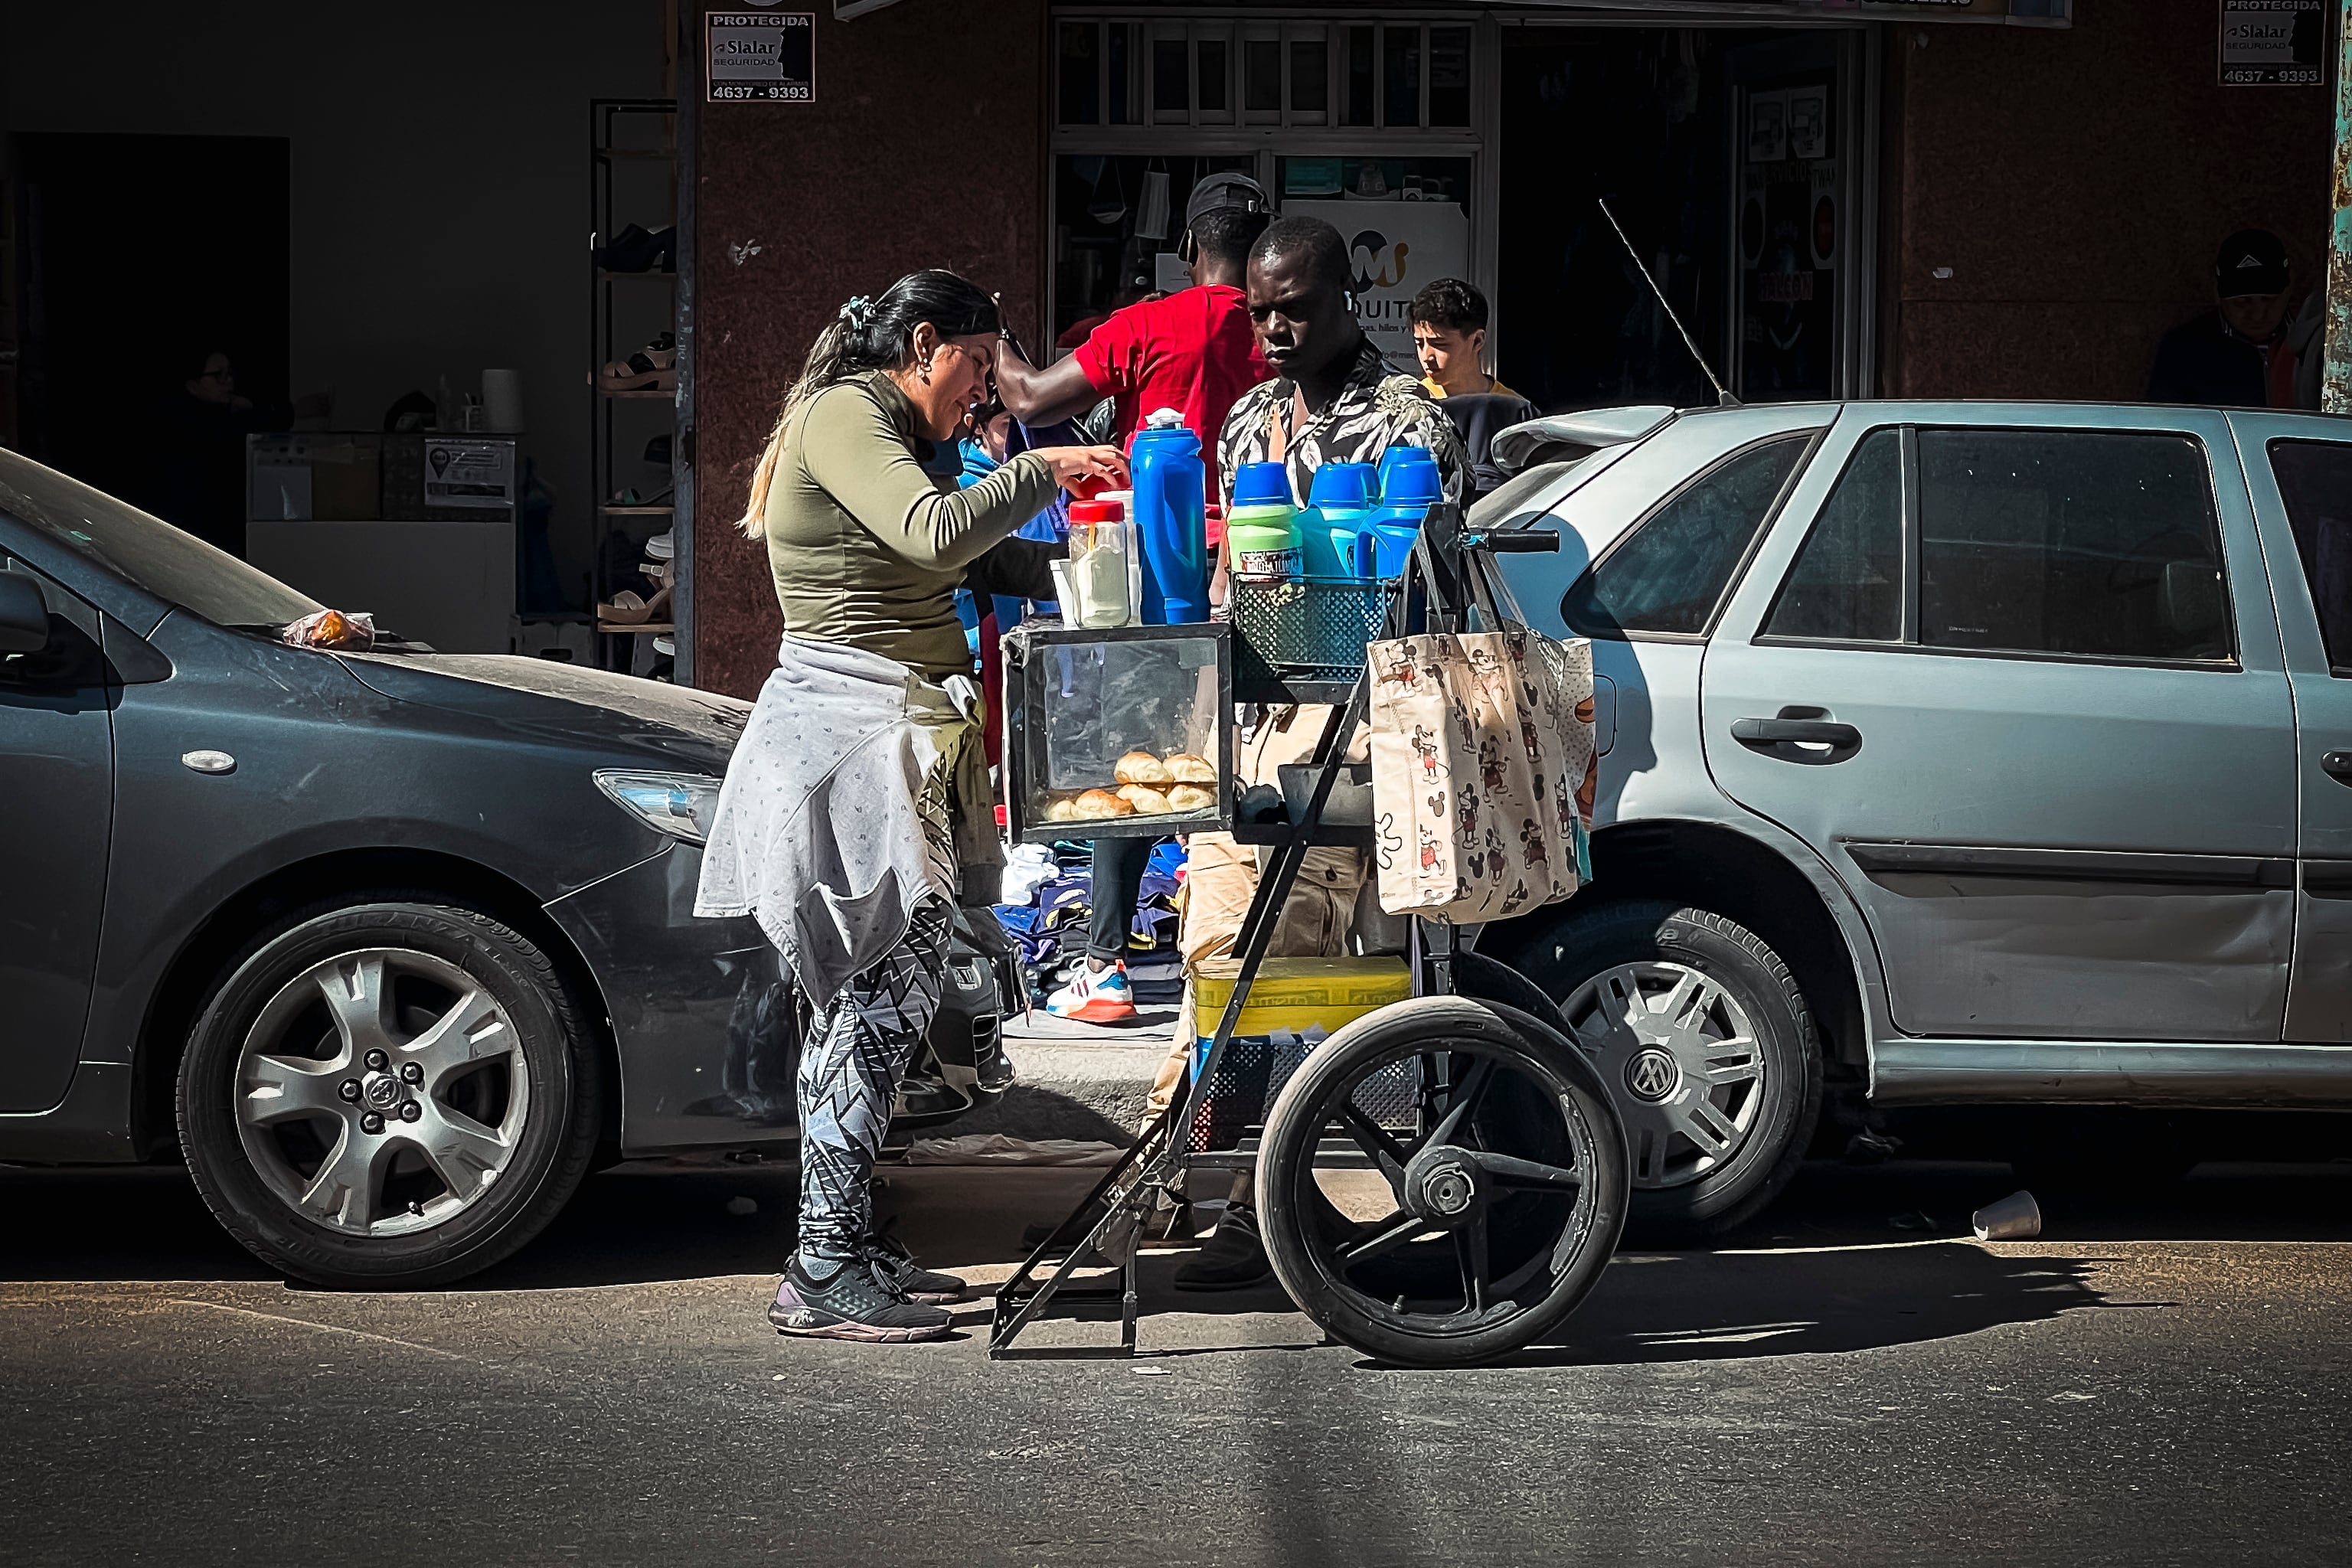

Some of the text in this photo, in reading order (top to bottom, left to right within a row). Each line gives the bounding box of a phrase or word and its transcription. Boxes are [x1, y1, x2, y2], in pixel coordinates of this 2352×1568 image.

[2226, 1, 2321, 10] PROTEGIDA
[714, 16, 808, 26] PROTEGIDA
[2224, 70, 2264, 83] 4637
[2278, 70, 2318, 82] 9393
[714, 87, 753, 98] 4637
[769, 87, 808, 98] 9393
[1355, 300, 1407, 318] UIT
[1379, 323, 1400, 332] hilos
